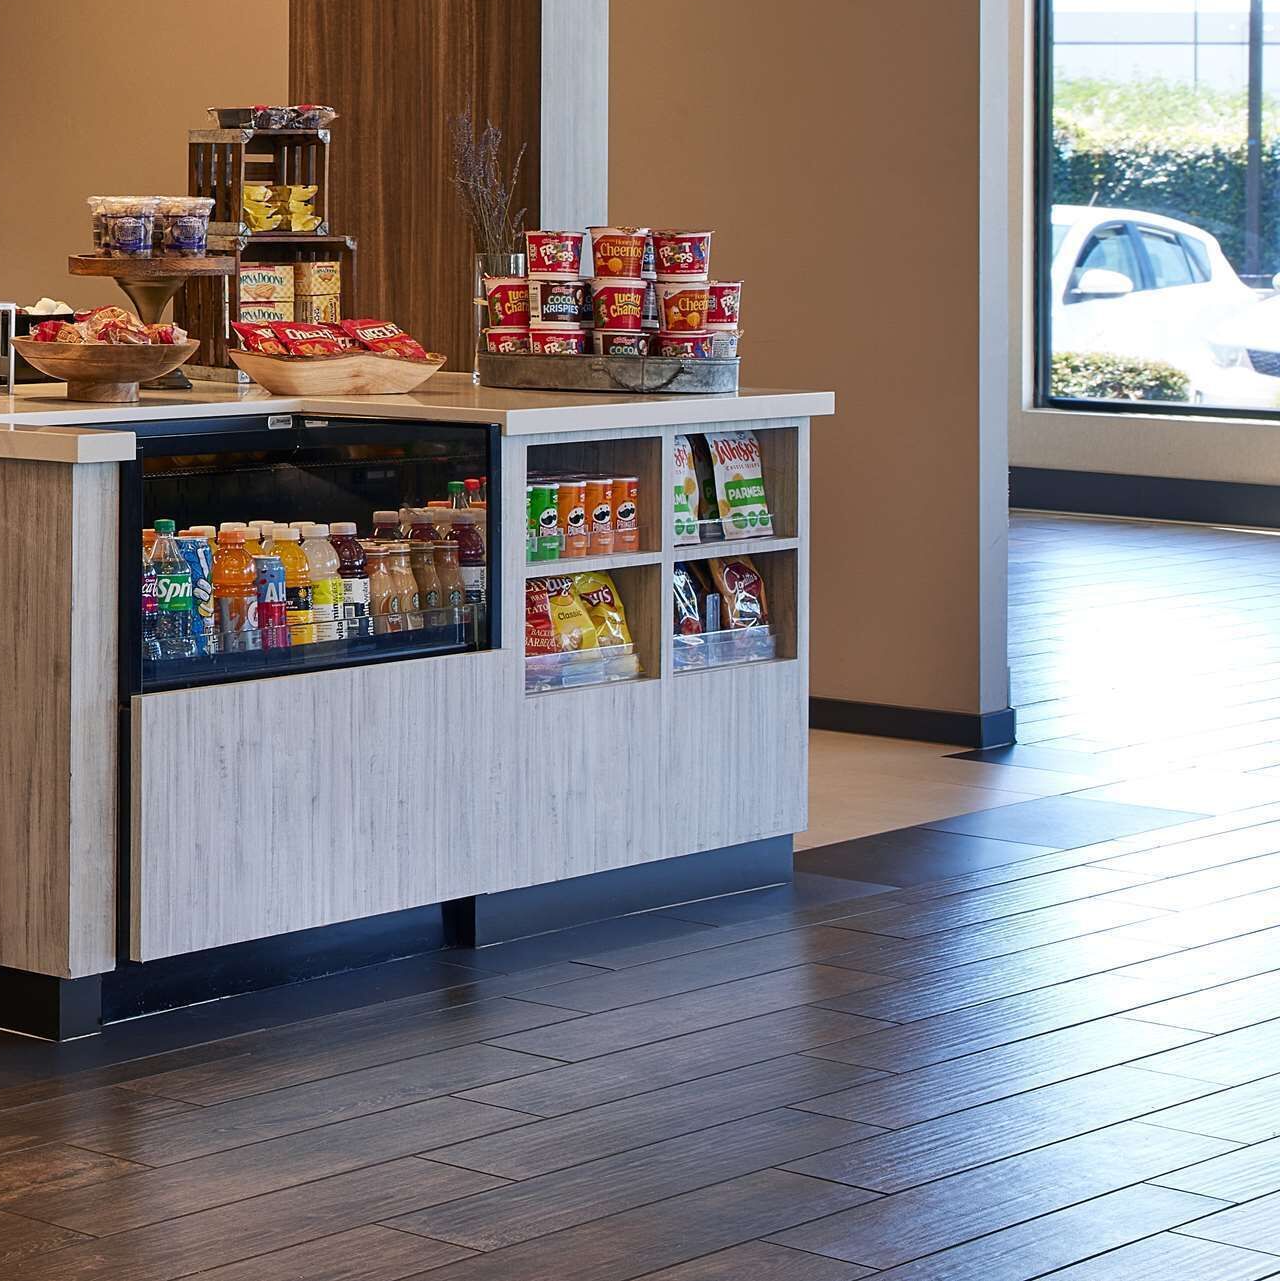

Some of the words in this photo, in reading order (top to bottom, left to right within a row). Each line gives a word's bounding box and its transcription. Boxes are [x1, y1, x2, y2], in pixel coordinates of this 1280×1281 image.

[600, 242, 642, 257] Cheerios
[548, 295, 576, 305] COCOA
[543, 305, 579, 315] KRISPIES
[609, 345, 638, 355] COCOA
[713, 438, 761, 465] Whisps
[557, 608, 583, 620] Classic
